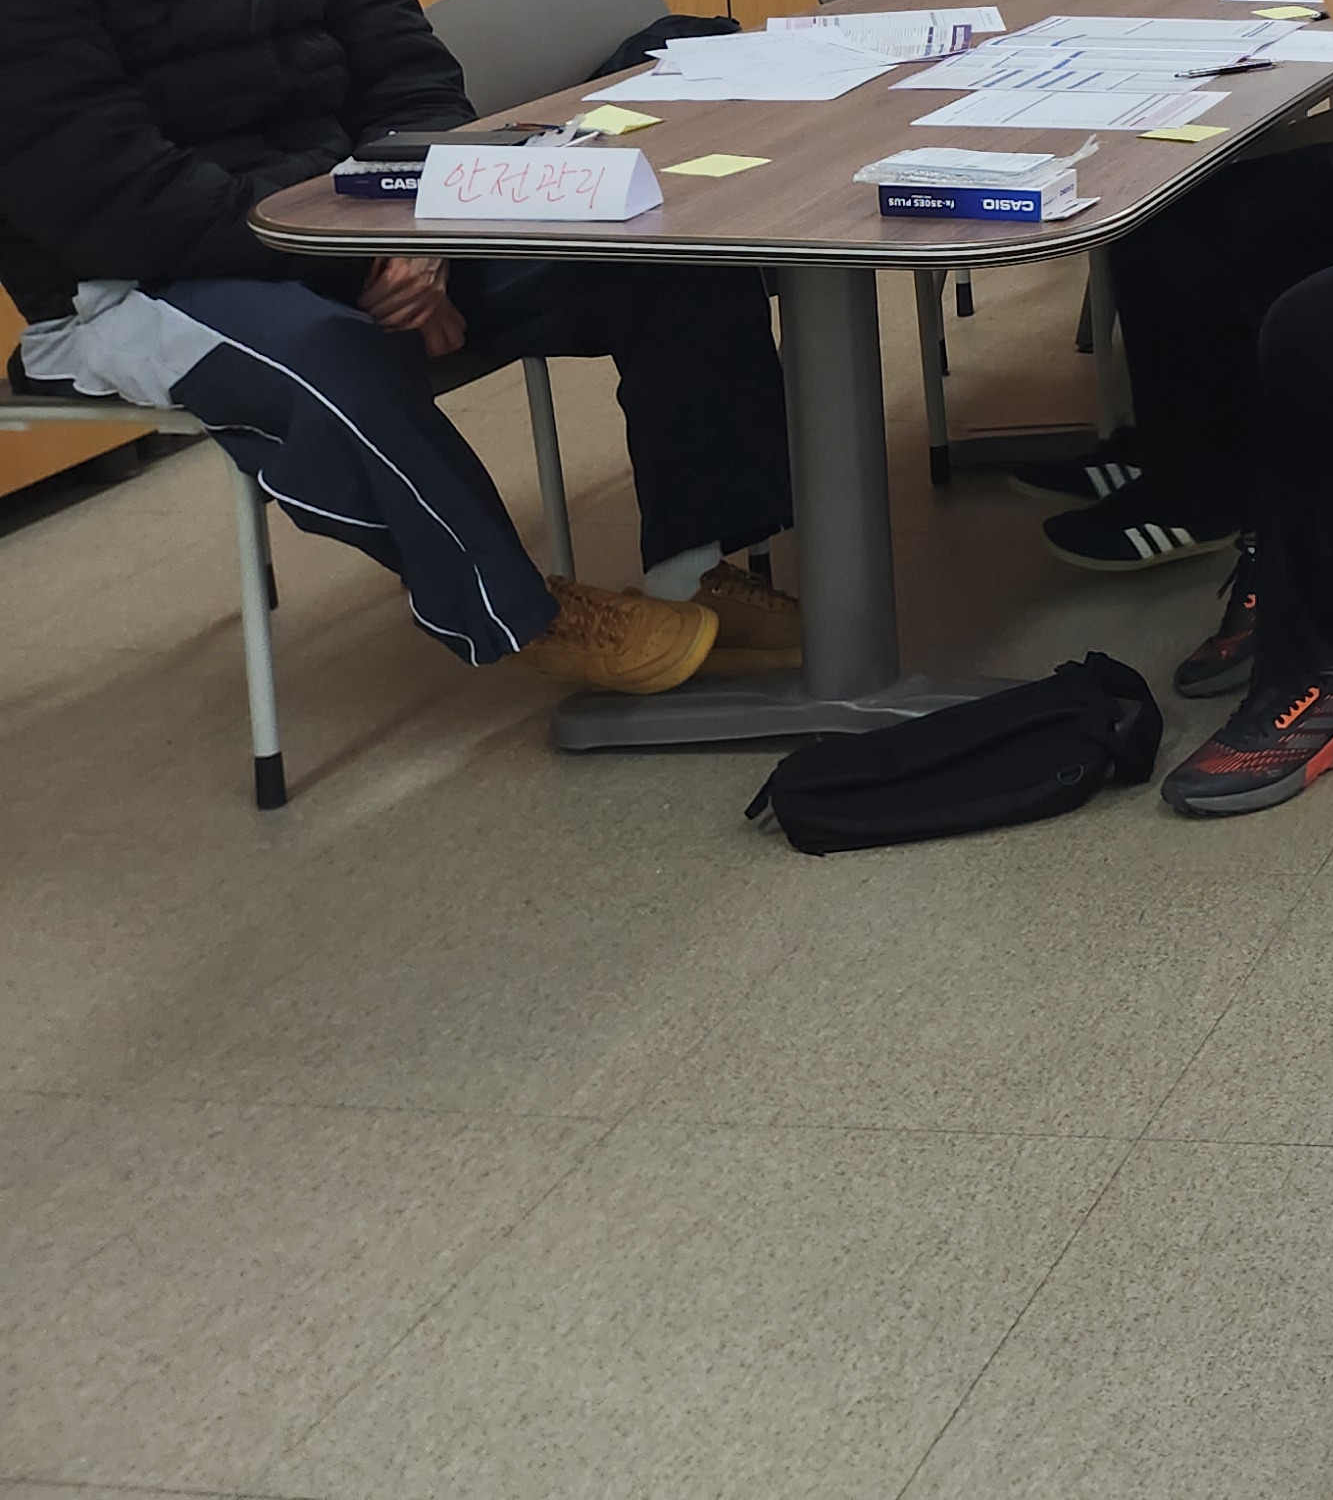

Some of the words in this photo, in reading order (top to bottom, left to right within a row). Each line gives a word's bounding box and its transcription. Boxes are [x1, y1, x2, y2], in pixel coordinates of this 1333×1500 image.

[381, 178, 419, 190] CAS
[444, 158, 606, 210] 안전관리
[888, 198, 912, 207] PLUS
[913, 197, 954, 210] fx-350ES
[983, 198, 1035, 212] CASIO
